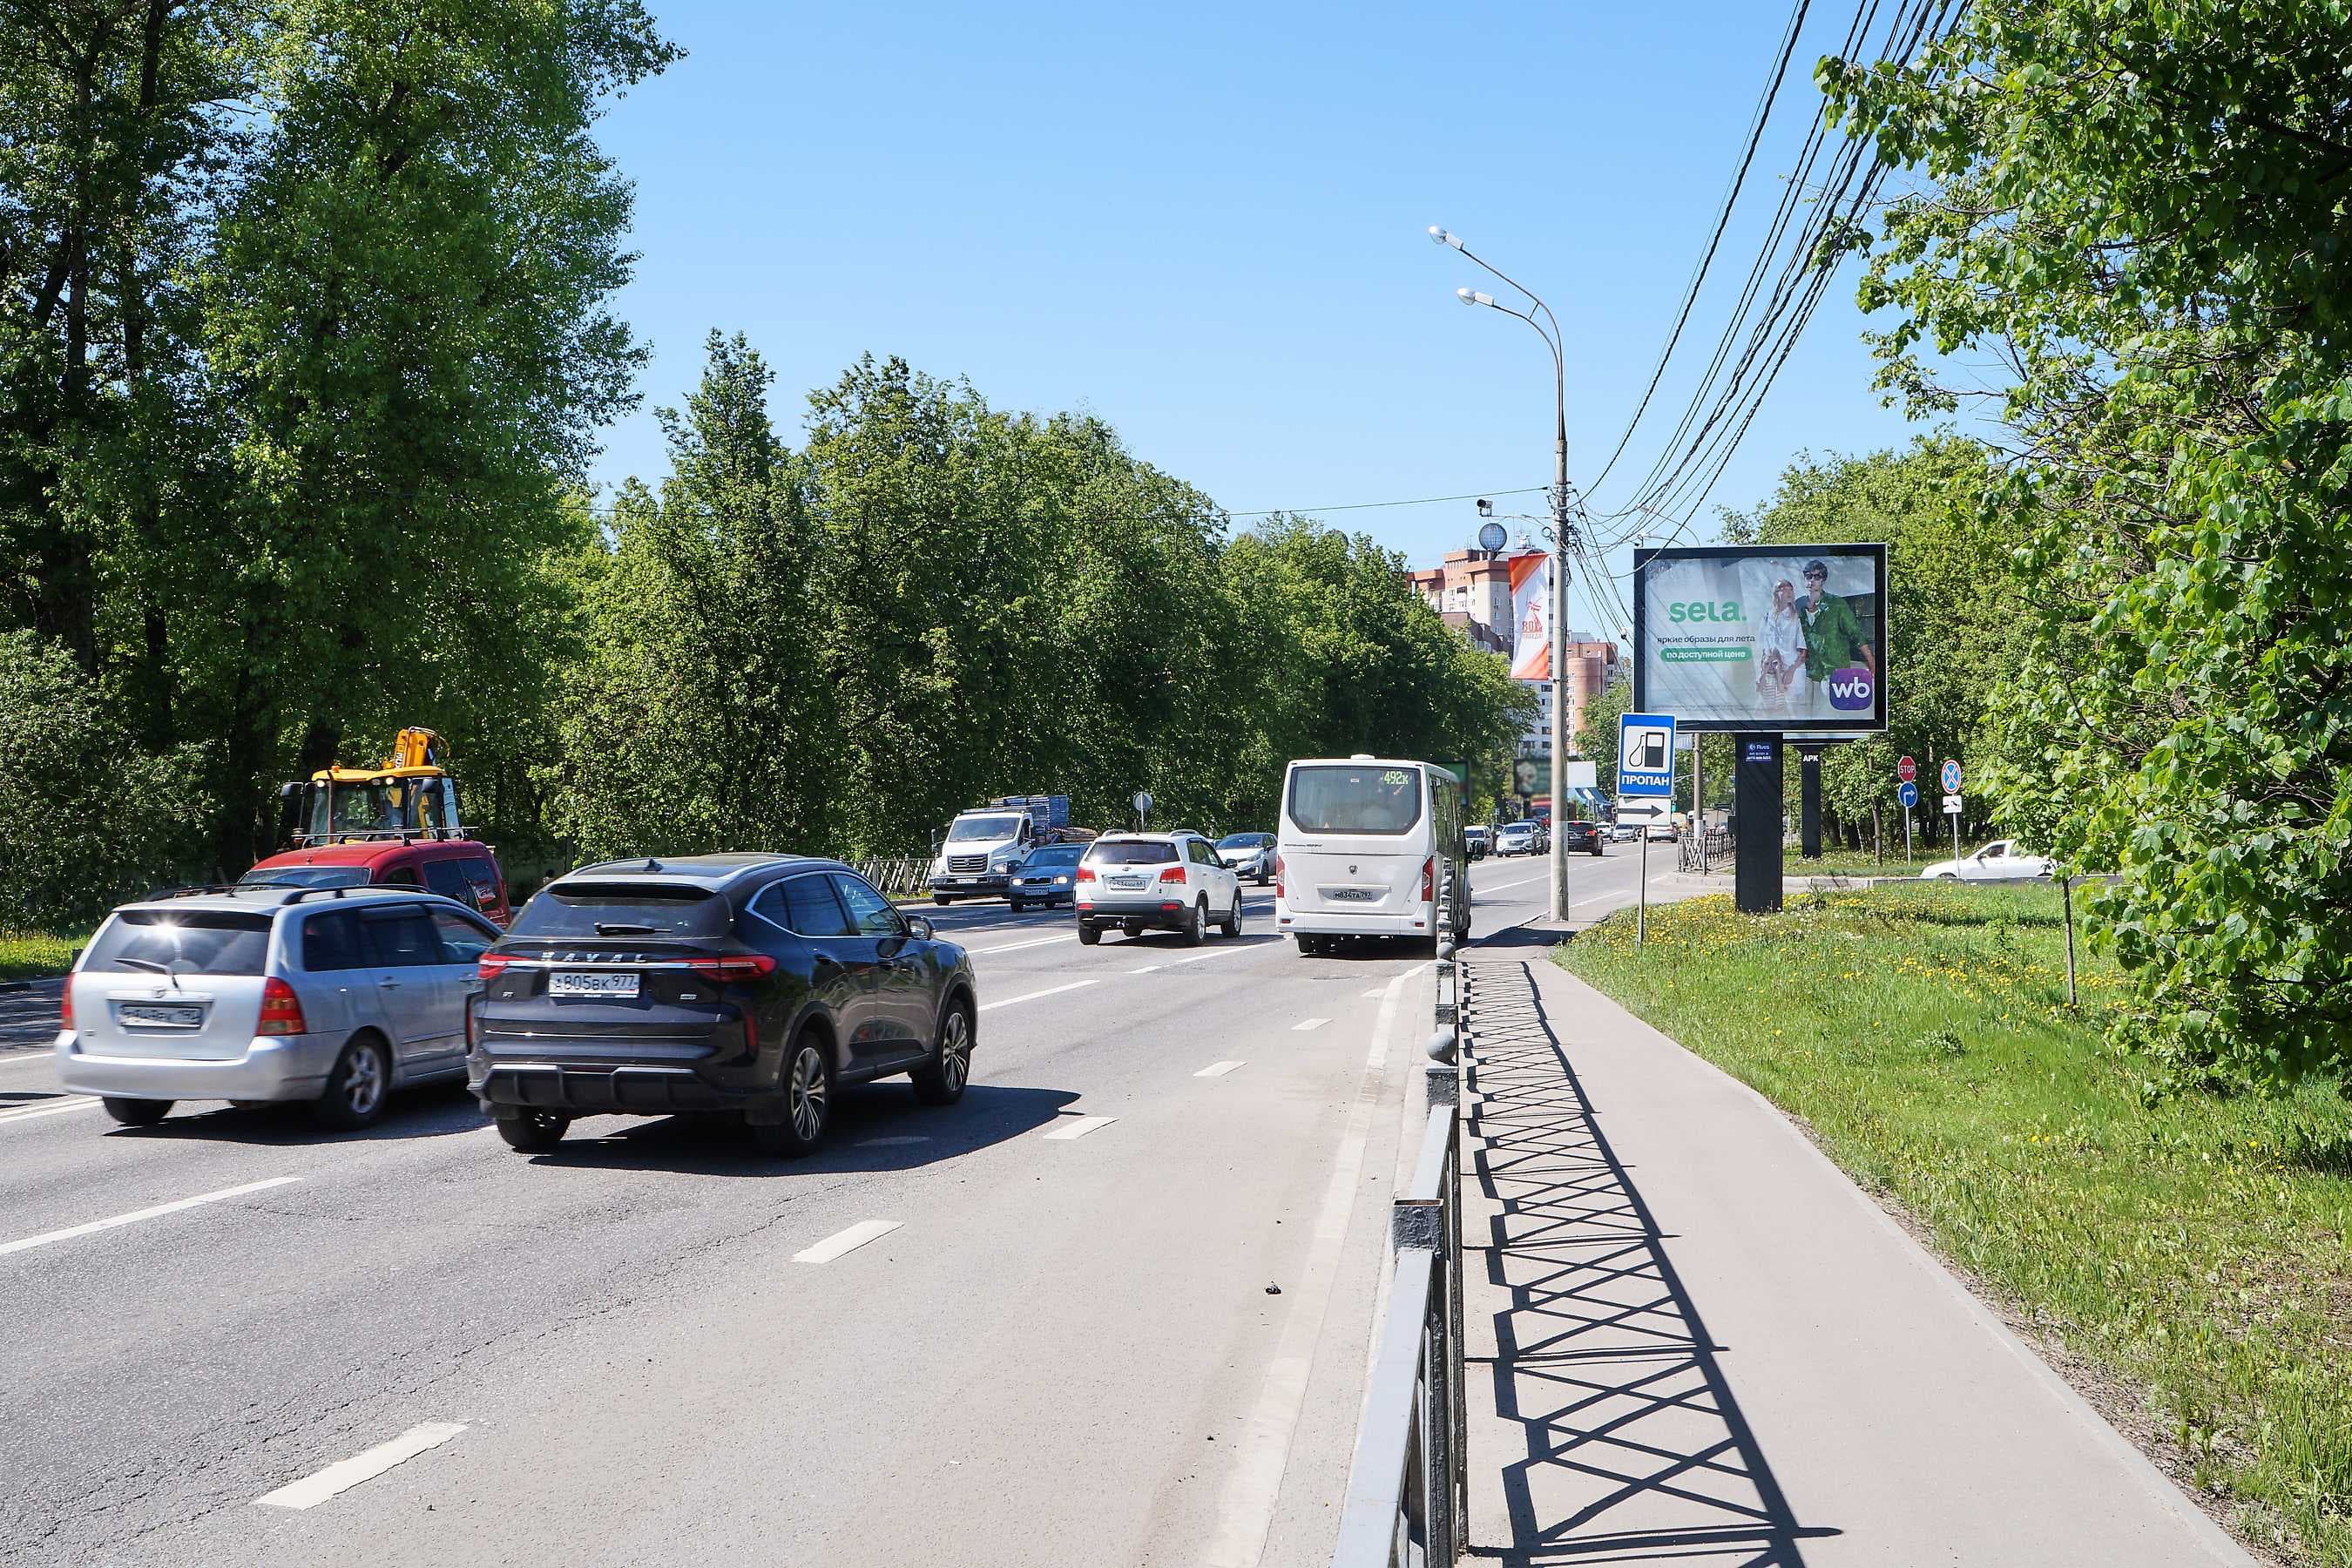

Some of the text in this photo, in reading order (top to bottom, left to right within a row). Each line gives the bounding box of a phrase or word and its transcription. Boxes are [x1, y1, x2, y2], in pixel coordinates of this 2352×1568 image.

[1669, 601, 1747, 623] sela.
[1684, 635, 1716, 644] образы
[1678, 650, 1723, 659] доступной
[1831, 676, 1870, 699] wb
[1900, 765, 1916, 774] STOP
[1621, 775, 1670, 786] ПРОПАН
[540, 951, 648, 963] HAVAL
